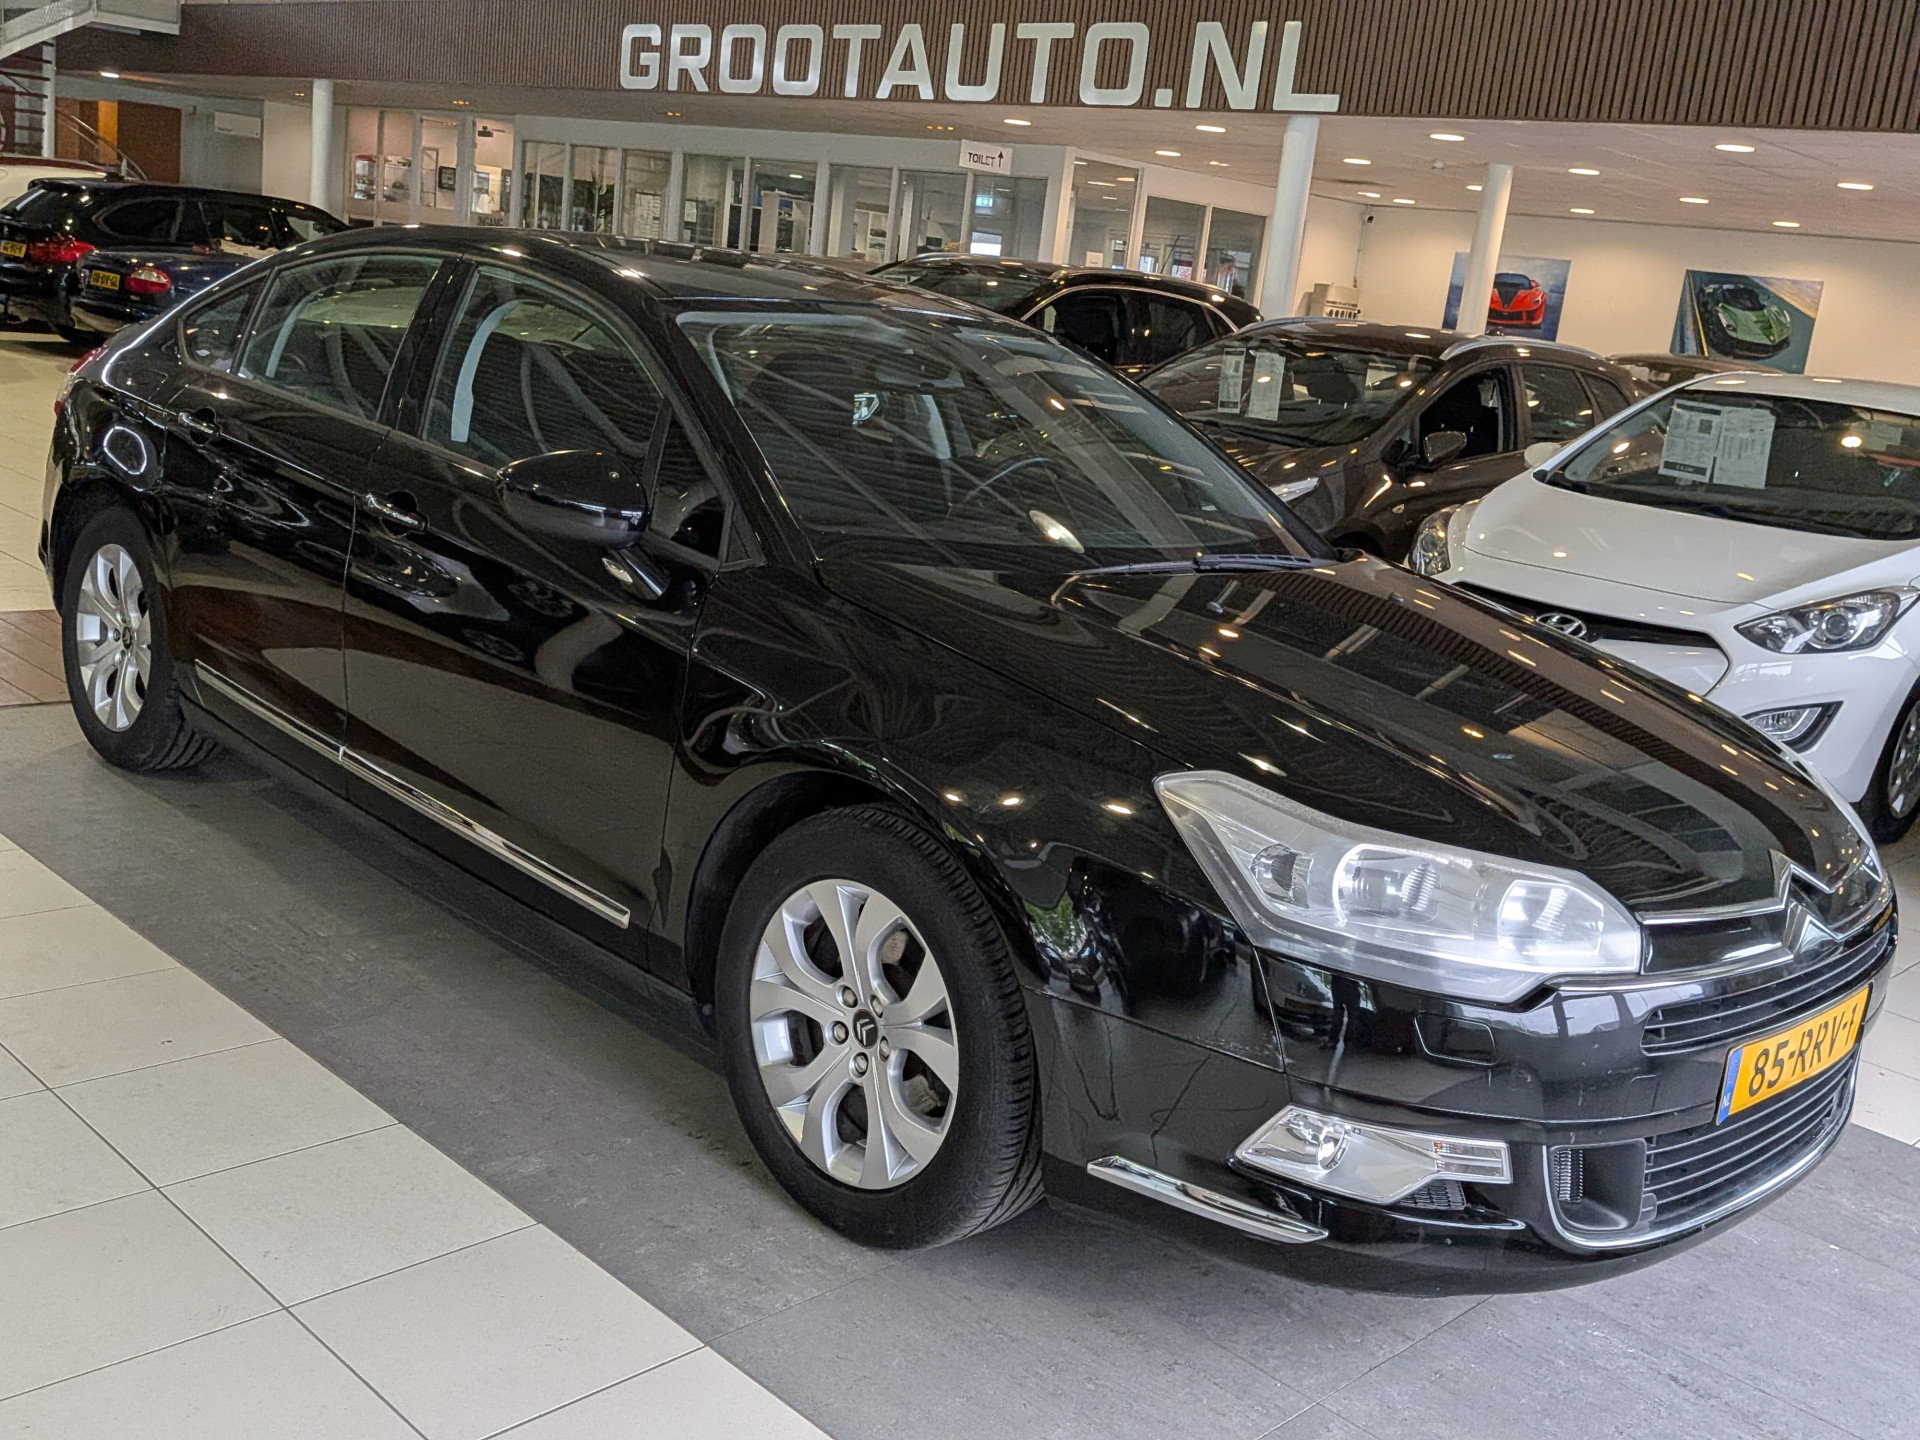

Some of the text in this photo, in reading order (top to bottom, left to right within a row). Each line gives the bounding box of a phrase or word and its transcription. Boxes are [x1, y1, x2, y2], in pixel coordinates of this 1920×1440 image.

[619, 21, 1341, 113] GROOTAUTO.NL
[967, 151, 996, 167] TOILET
[1748, 1001, 1858, 1097] 85-RRV-1
